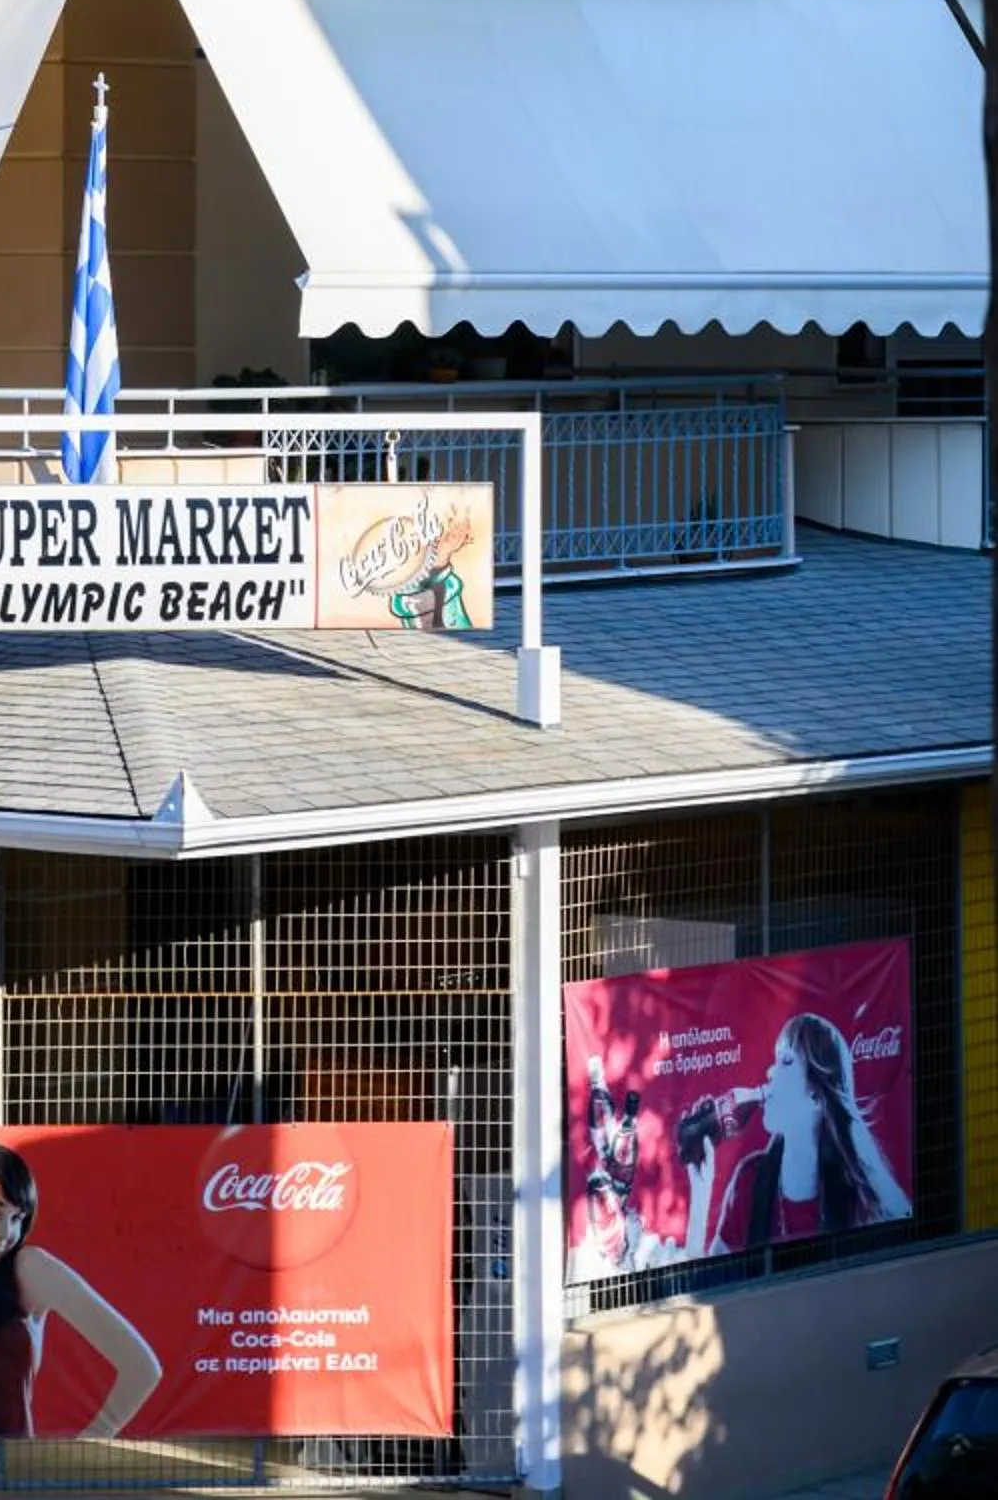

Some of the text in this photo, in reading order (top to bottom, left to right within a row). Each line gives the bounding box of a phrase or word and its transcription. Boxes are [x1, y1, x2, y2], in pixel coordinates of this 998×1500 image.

[115, 495, 311, 565] MARKET
[159, 577, 305, 621] BEACH"
[197, 1305, 370, 1325] Μια απολαυστική
[231, 1330, 337, 1348] Coca-Cola
[195, 1353, 379, 1374] σε περιμένει ΕΔΩ!
